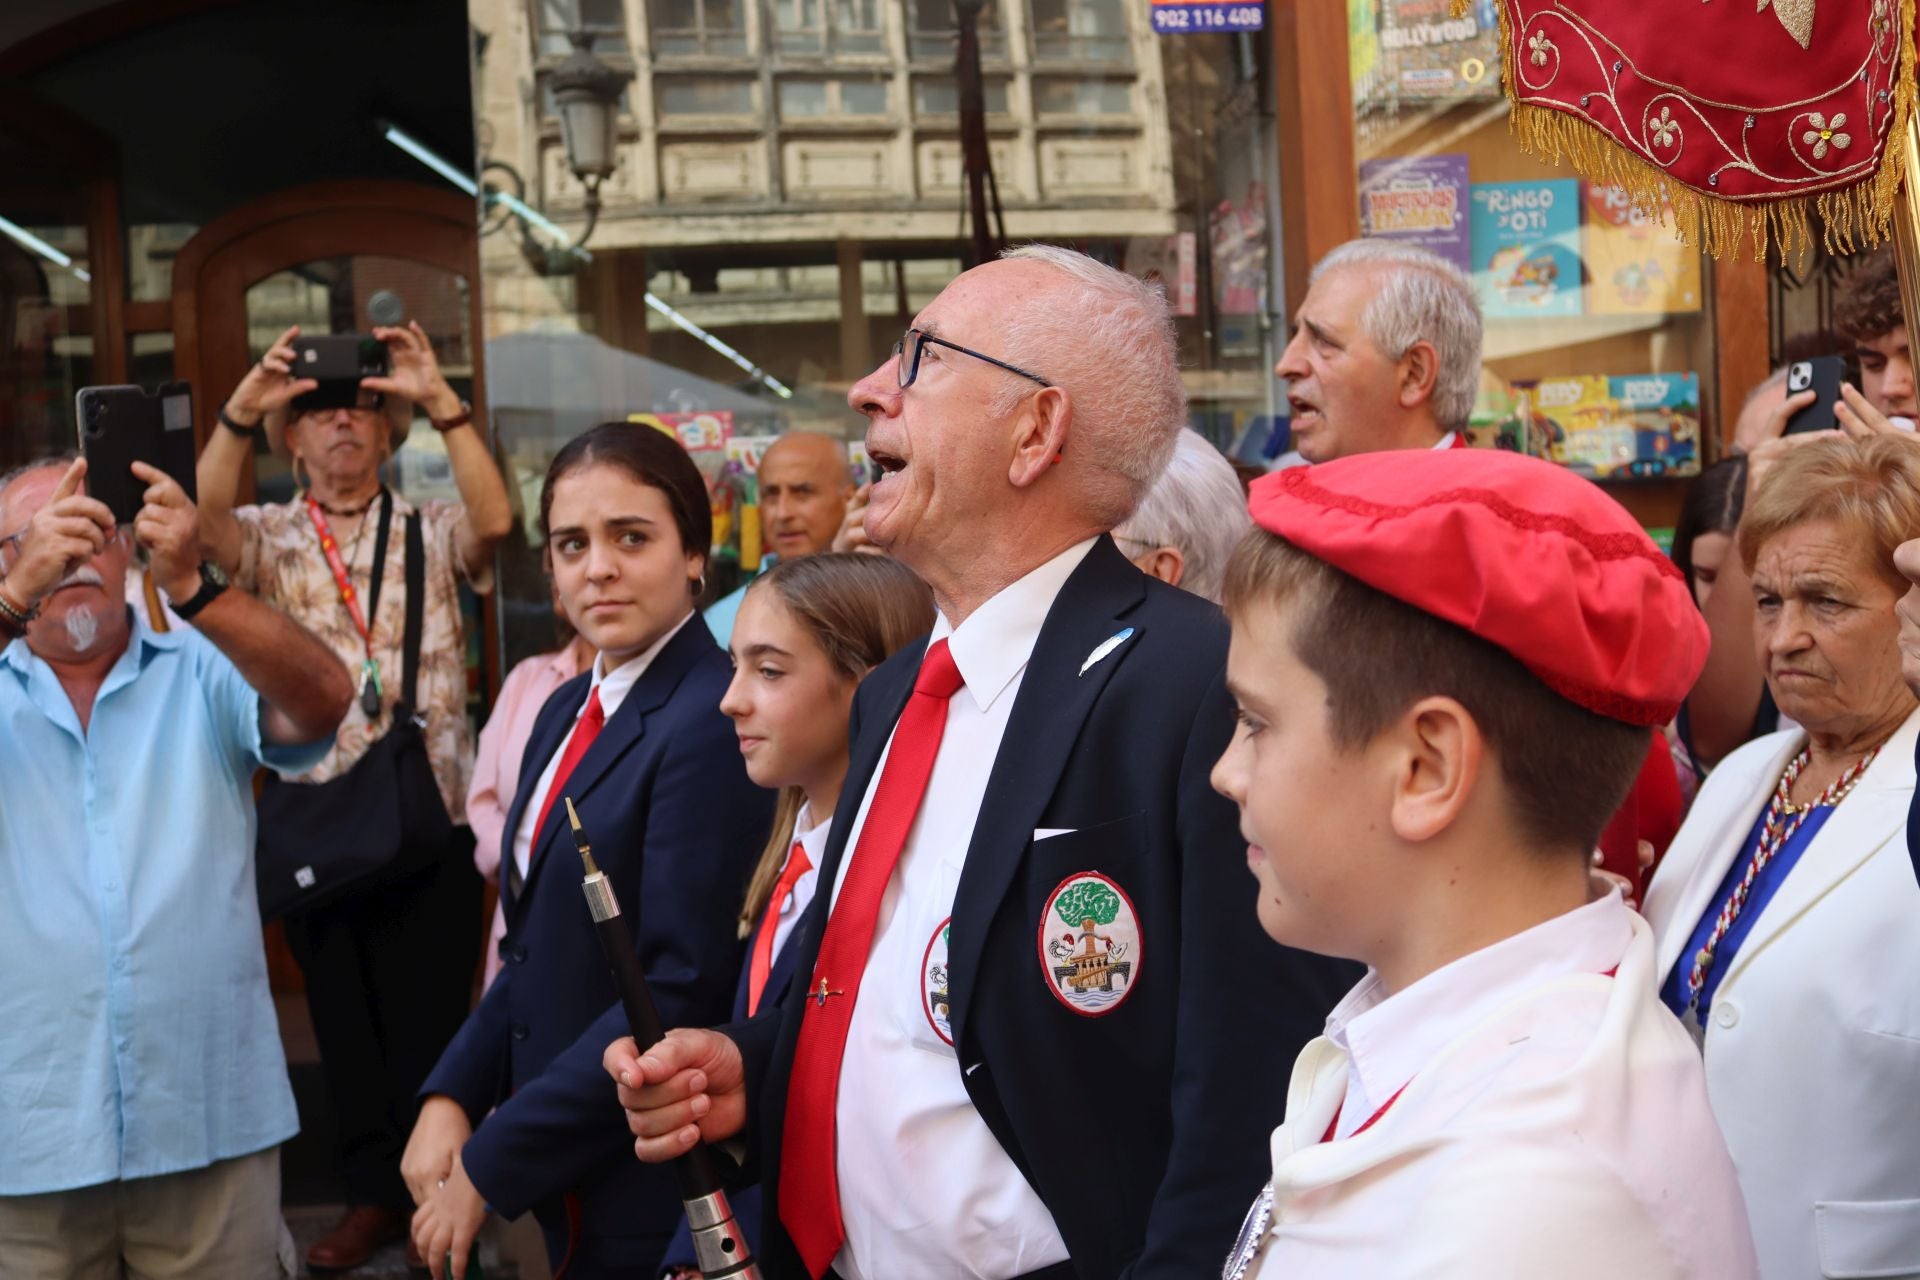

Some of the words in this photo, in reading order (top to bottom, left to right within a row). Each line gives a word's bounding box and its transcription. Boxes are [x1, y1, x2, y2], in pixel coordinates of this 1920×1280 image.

[1155, 9, 1189, 27] 902
[1192, 8, 1225, 26] 116
[1381, 16, 1477, 49] HOLLYWOOD
